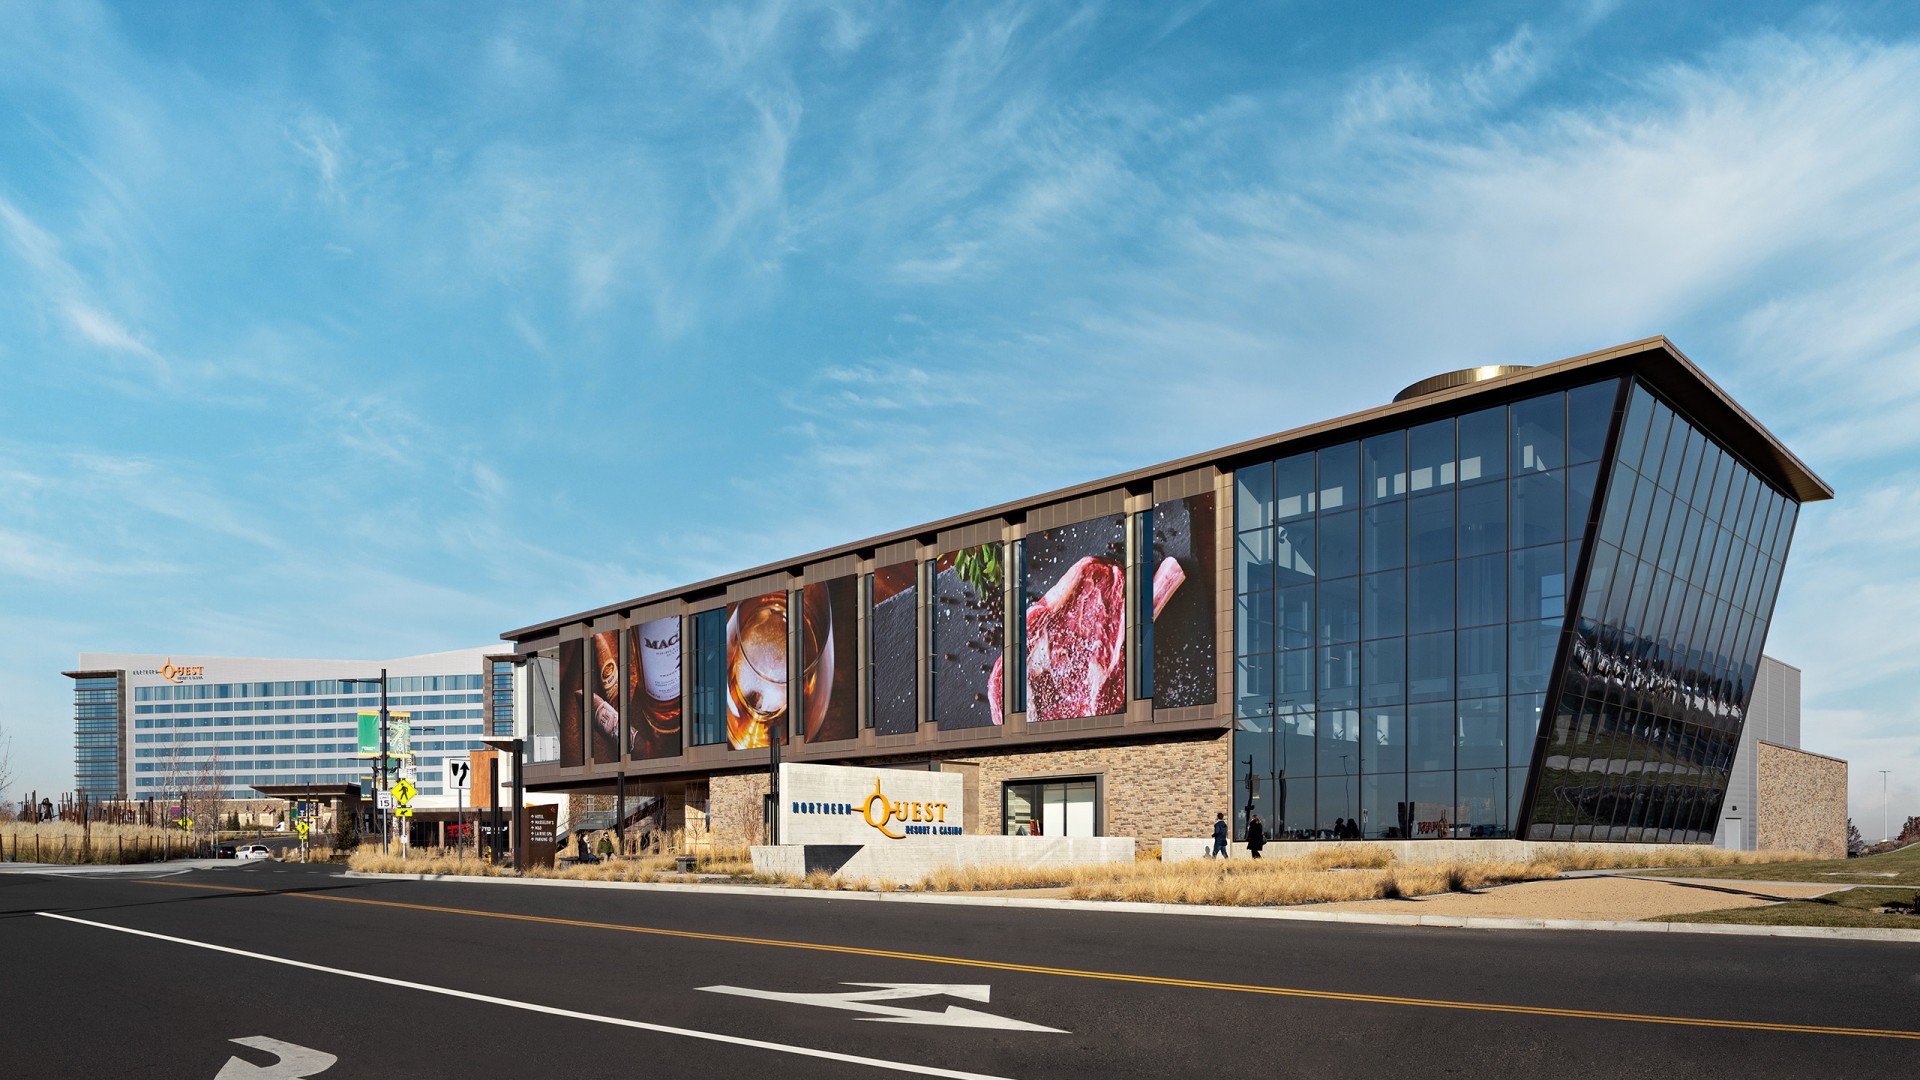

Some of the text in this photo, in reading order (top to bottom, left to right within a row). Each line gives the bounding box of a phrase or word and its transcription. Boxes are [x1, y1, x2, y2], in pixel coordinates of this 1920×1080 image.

[161, 657, 204, 683] QUEST
[792, 775, 948, 839] NORTHERN QUEST
[905, 825, 963, 835] RESORT & CASINO
